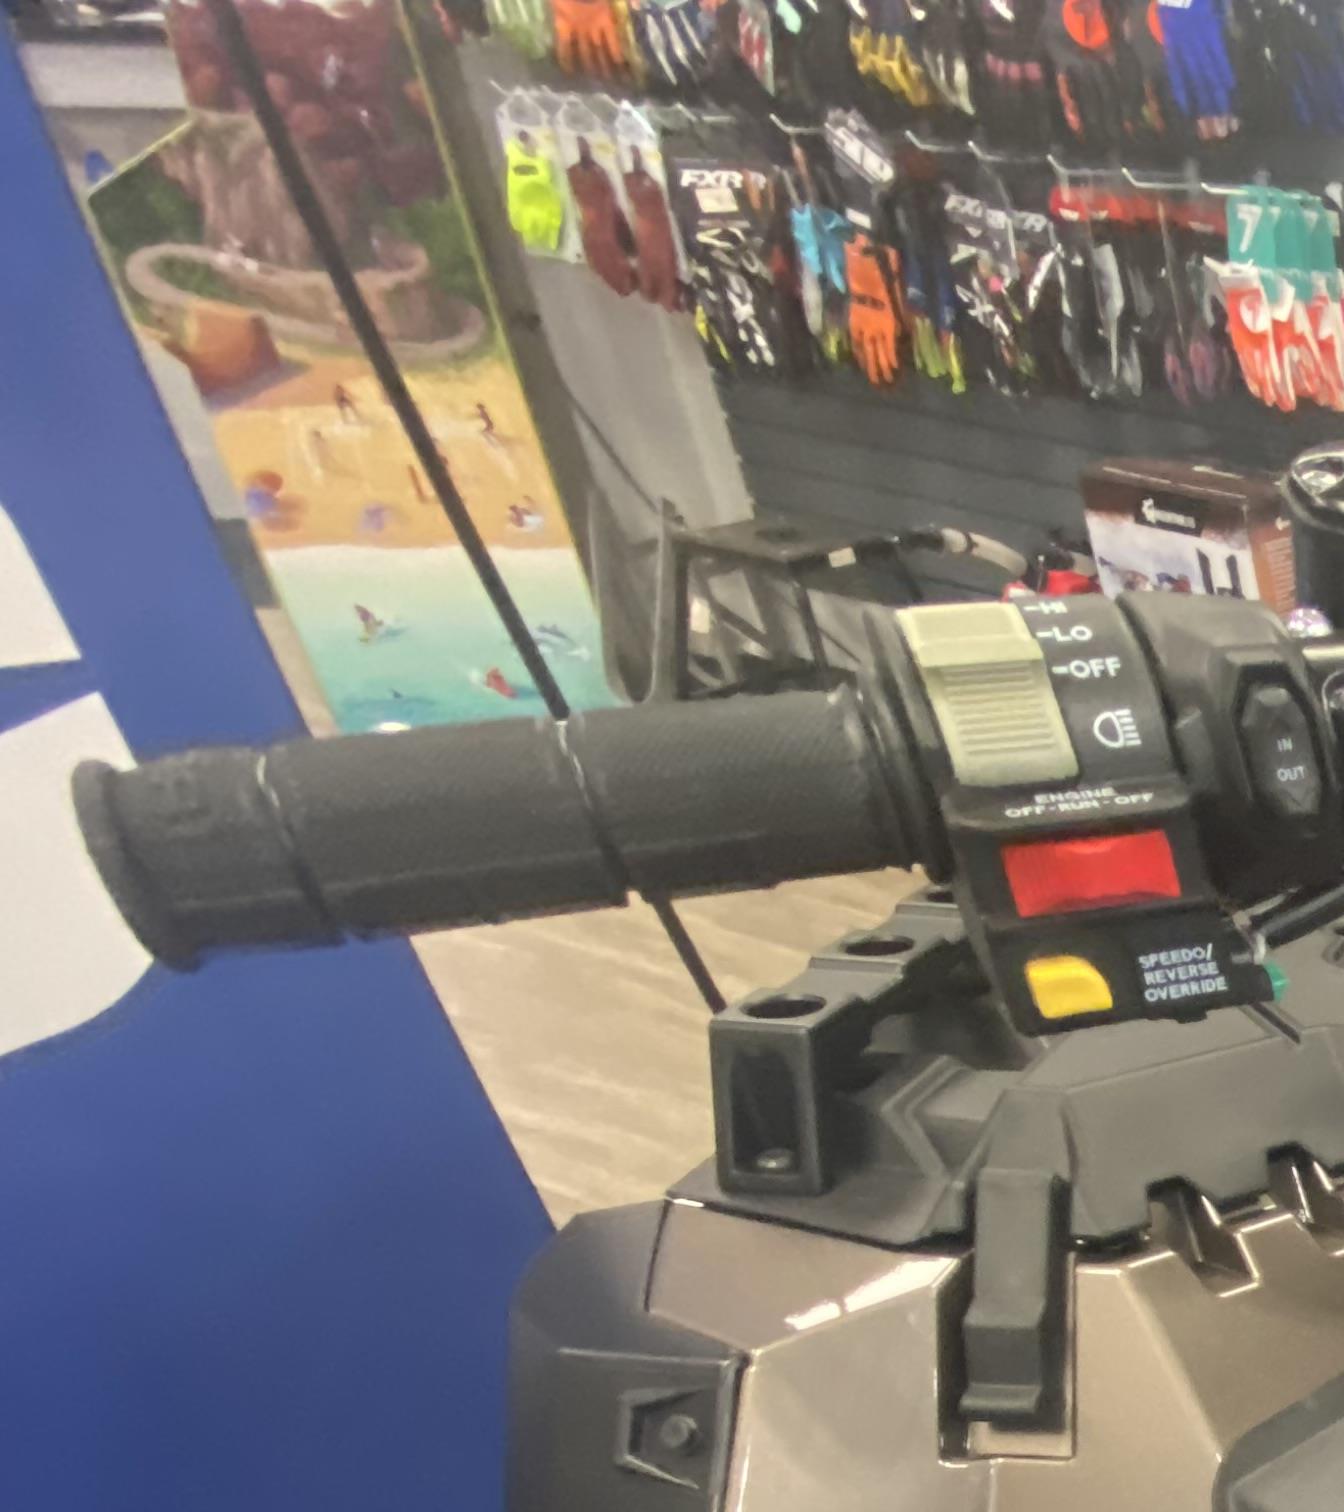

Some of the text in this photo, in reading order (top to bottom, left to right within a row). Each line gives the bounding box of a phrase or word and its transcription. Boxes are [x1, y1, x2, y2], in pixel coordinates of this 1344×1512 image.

[680, 168, 743, 189] FXR
[1052, 625, 1093, 643] LO
[1069, 657, 1121, 679] OFF
[1277, 737, 1293, 752] IN
[1276, 765, 1306, 782] OUT
[1034, 787, 1118, 804] ENGINE
[1138, 942, 1213, 969] SPEEDO/
[1144, 962, 1220, 986] REVERSE
[1145, 976, 1229, 1002] OVERRIDE
